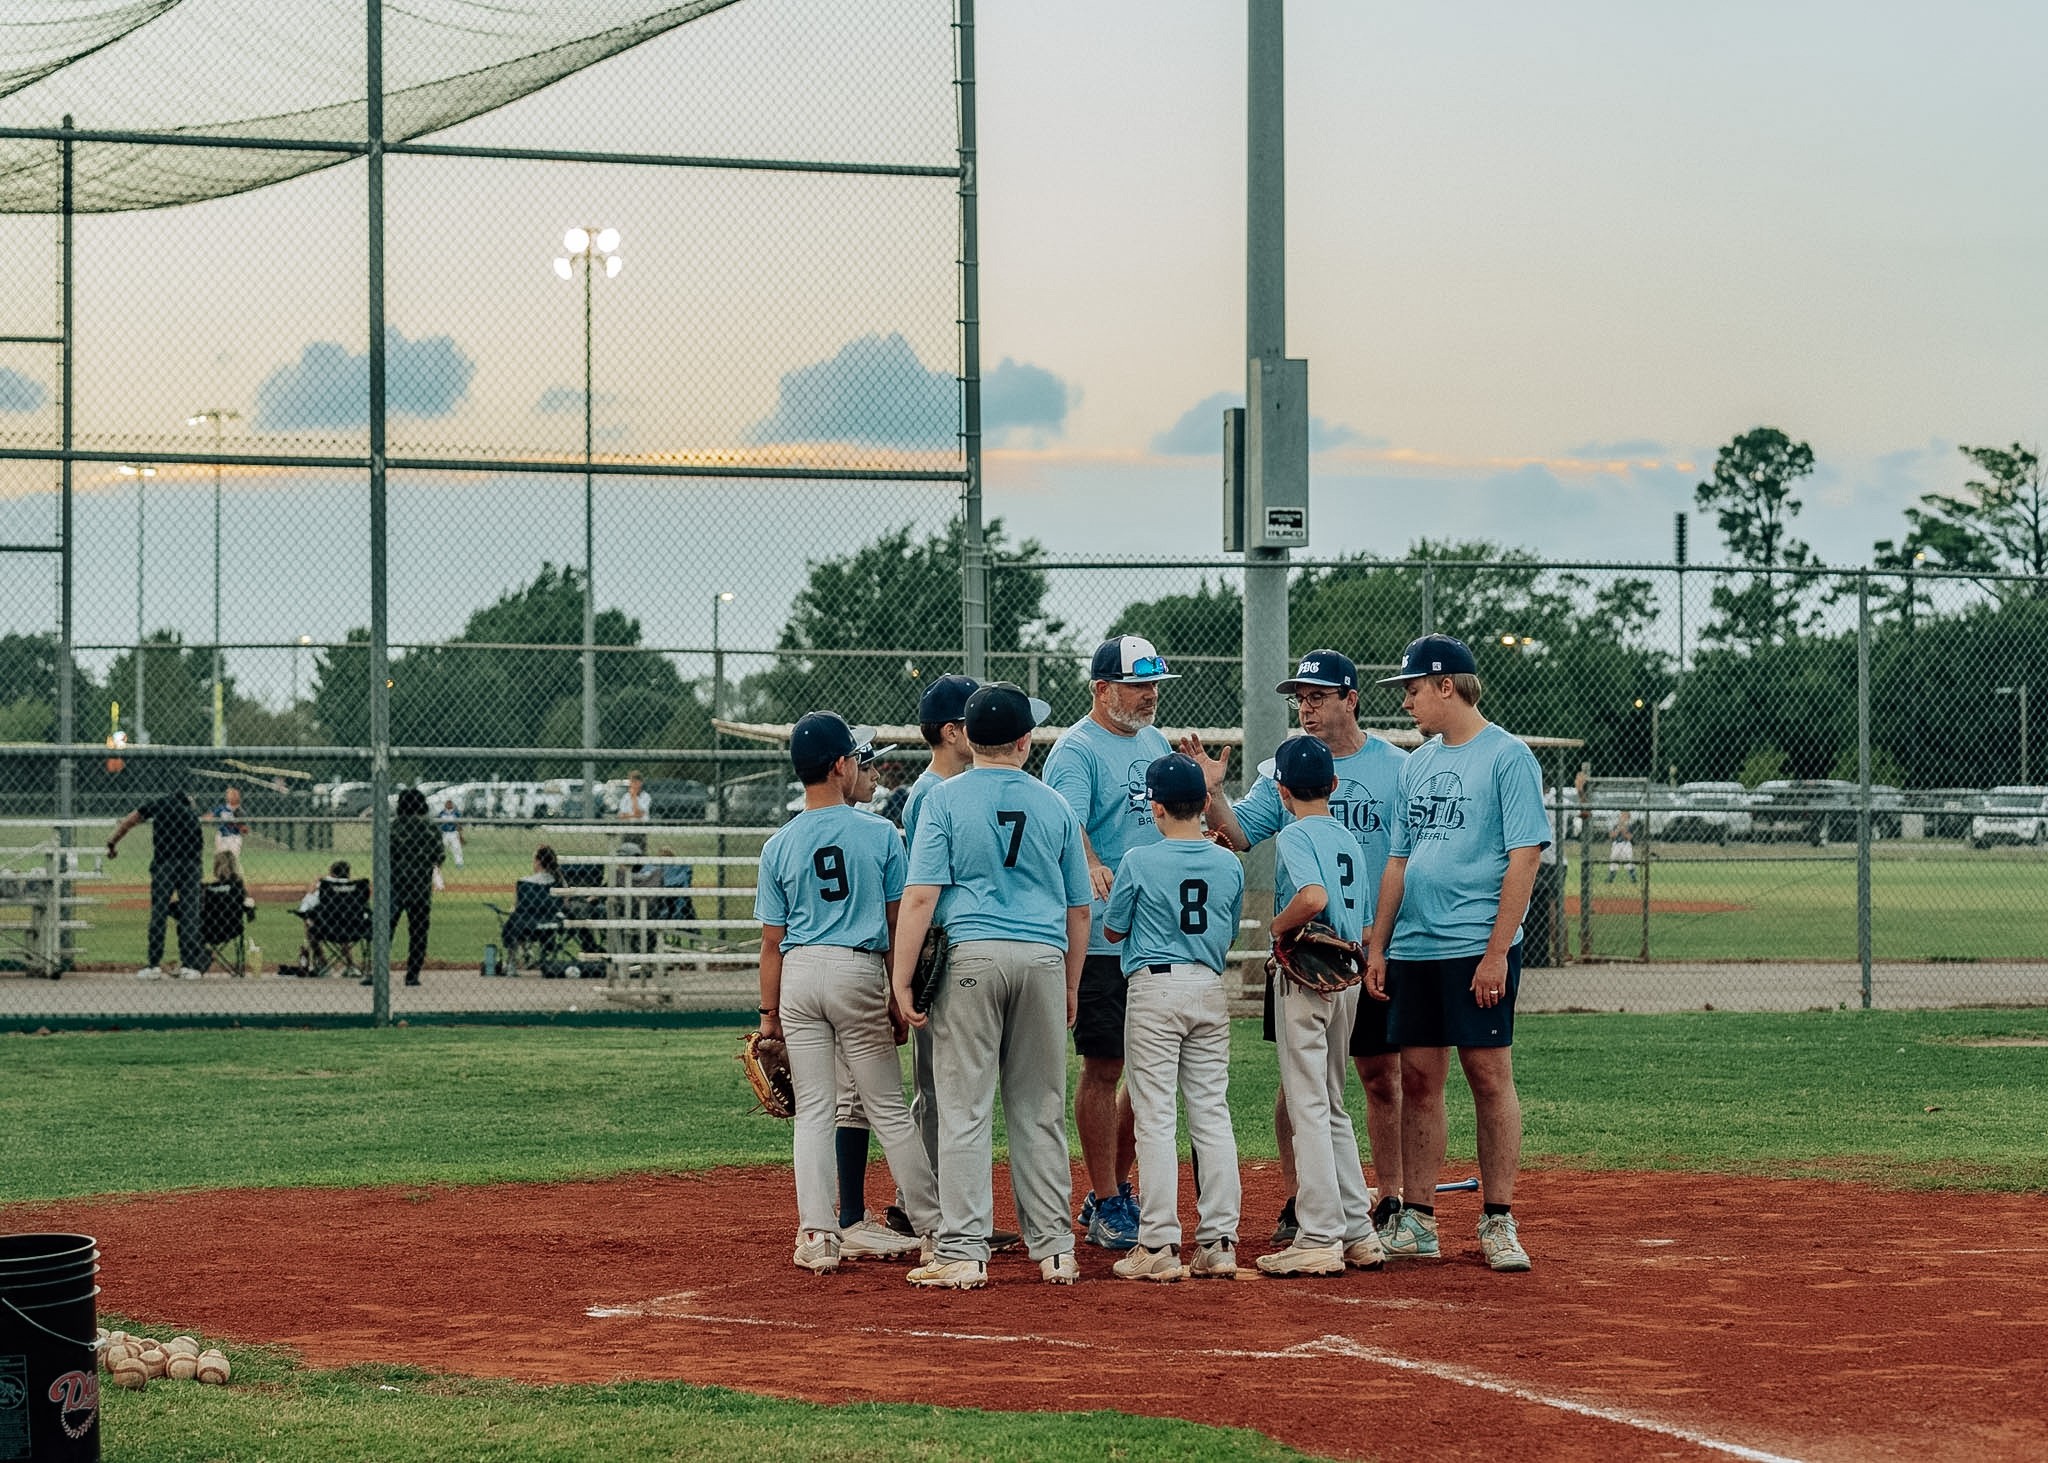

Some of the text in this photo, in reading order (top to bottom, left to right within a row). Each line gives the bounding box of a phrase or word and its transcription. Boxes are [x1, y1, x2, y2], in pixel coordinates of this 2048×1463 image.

[996, 810, 1027, 868] 7
[1327, 799, 1384, 833] DG
[813, 845, 850, 902] 9
[1336, 852, 1355, 910] 2
[1179, 878, 1209, 935] 8
